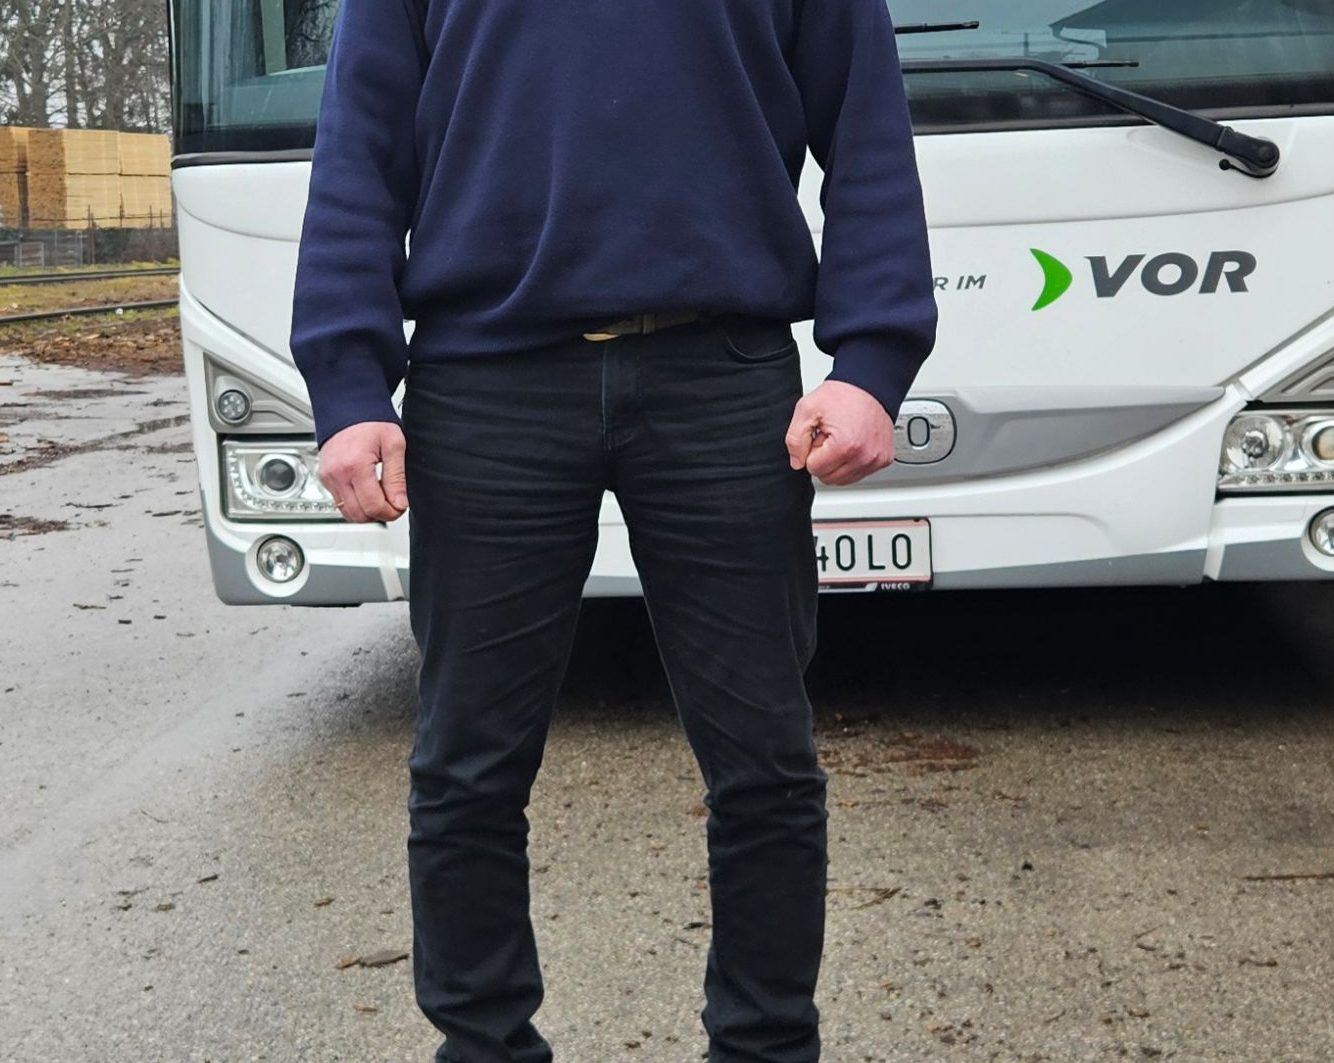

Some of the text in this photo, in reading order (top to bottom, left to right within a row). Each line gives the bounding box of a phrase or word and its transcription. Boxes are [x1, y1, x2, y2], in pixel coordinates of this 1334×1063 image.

[956, 274, 987, 290] IM
[1083, 250, 1257, 298] VOR
[881, 582, 910, 590] IVECO
